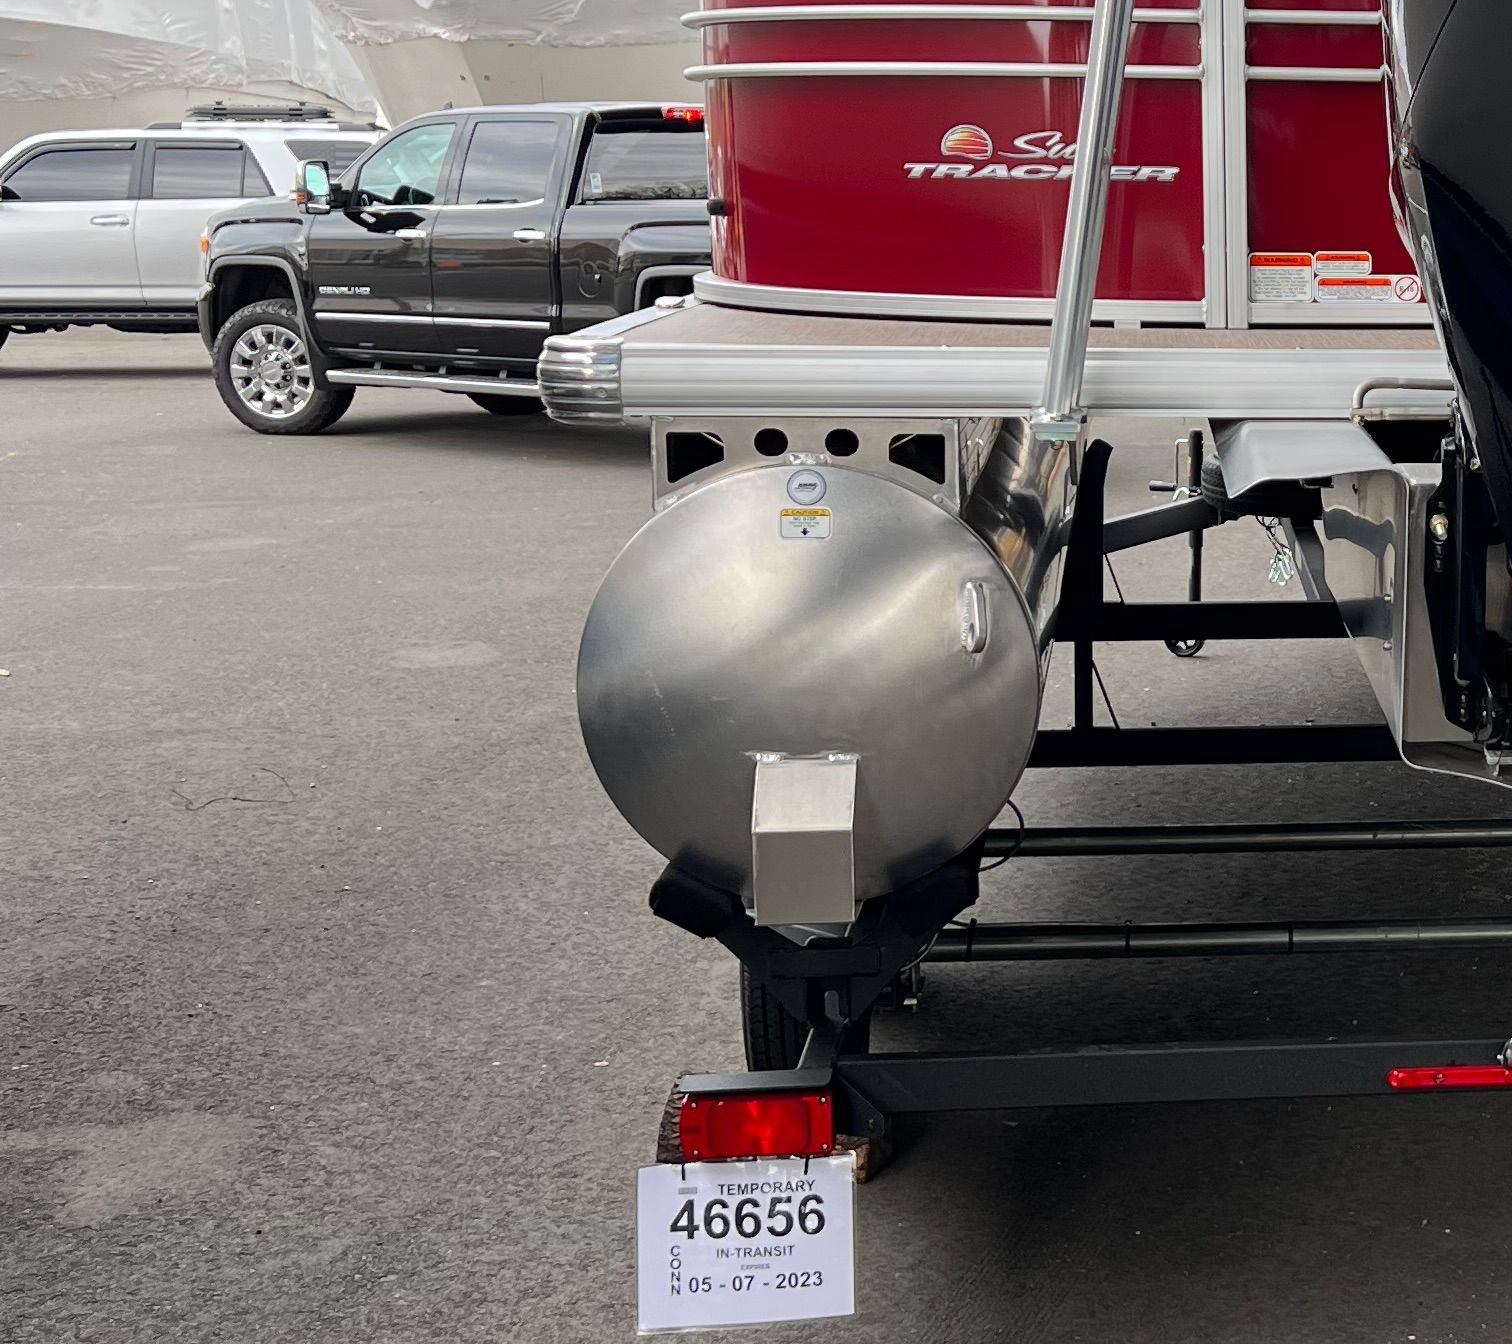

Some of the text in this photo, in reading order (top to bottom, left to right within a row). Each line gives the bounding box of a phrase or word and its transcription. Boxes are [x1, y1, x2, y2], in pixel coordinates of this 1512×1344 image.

[998, 130, 1082, 159] Su
[717, 1179, 816, 1196] TEMPORARY
[669, 1194, 826, 1240] 46656
[716, 1244, 796, 1259] IN-TRANSIT
[740, 1262, 771, 1271] EXPIRES
[688, 1276, 712, 1293] 05
[732, 1274, 755, 1292] 07
[775, 1271, 824, 1289] 2023
